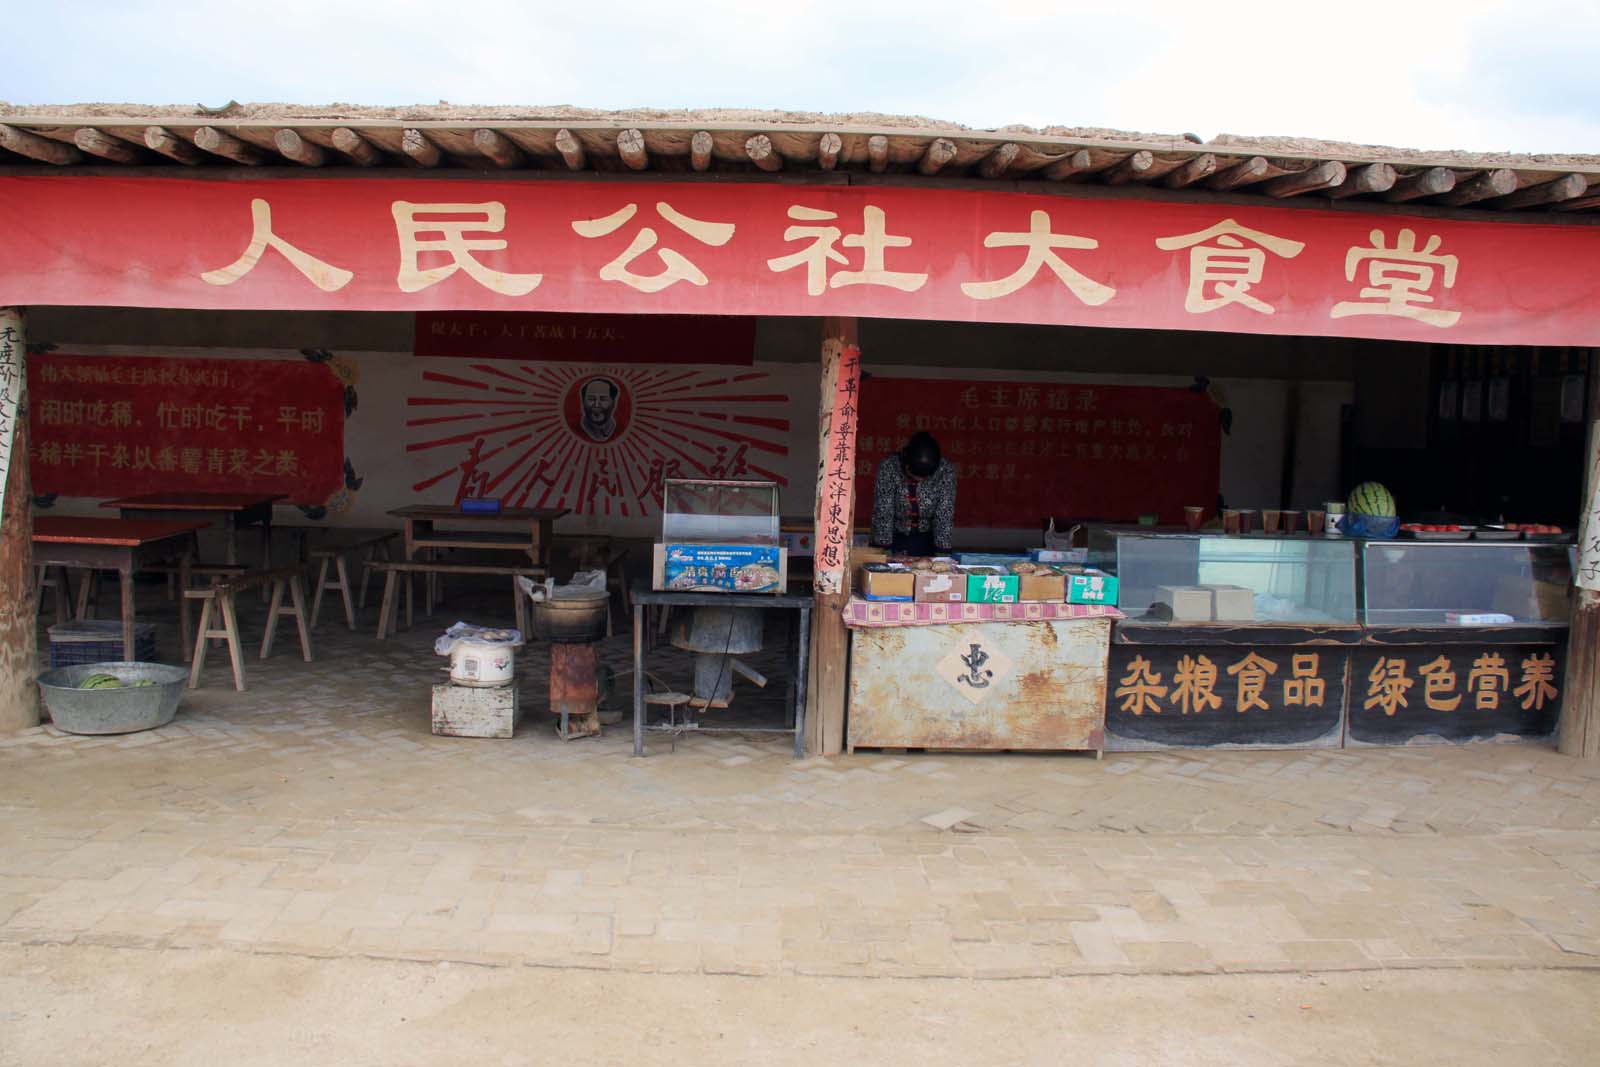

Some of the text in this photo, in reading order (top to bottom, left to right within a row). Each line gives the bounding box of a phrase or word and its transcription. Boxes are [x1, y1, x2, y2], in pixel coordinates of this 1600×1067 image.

[200, 197, 1462, 329] 人民公社大食堂
[957, 643, 993, 688] 忠
[1114, 651, 1326, 715] 杂粮食品
[1363, 651, 1558, 716] 绿色营养
